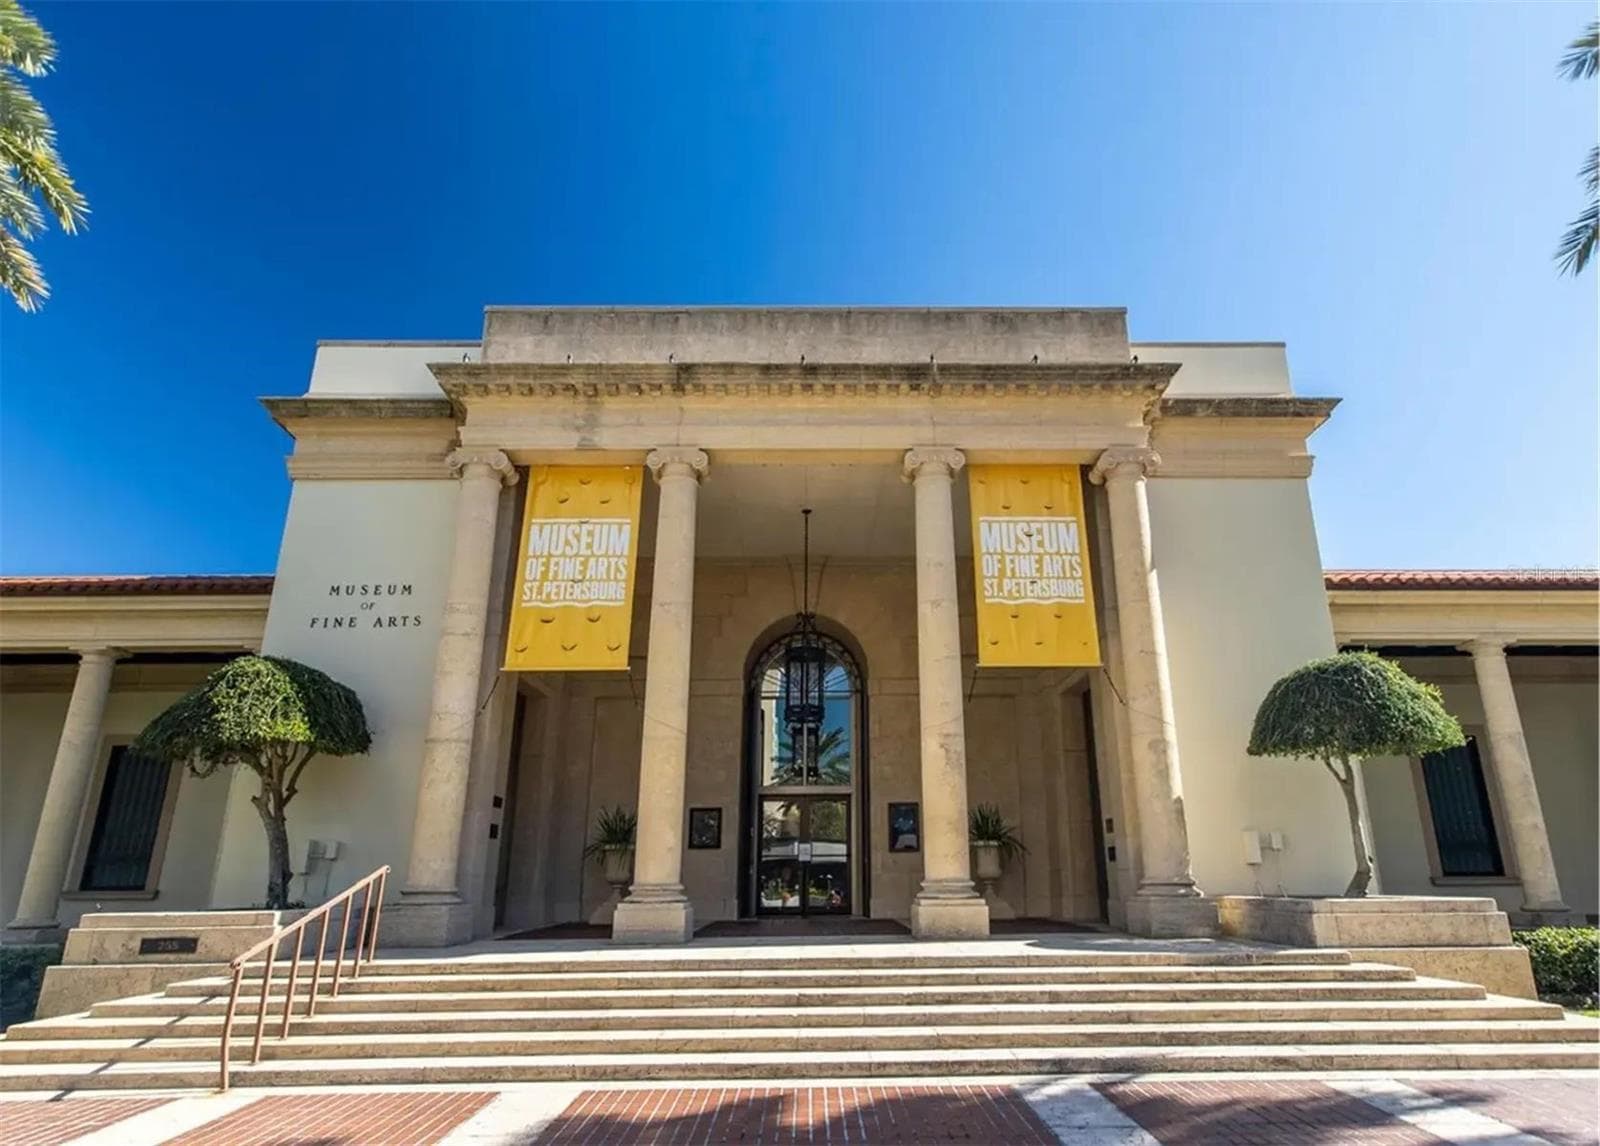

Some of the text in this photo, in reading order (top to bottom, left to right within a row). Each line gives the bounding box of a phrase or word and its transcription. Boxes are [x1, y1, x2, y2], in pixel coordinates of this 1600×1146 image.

[527, 523, 630, 557] MUSEUM
[980, 521, 1079, 554] MUSEUM
[525, 557, 628, 581] OF FINE ARTS
[982, 554, 1083, 577] OF FINE ARTS
[329, 584, 413, 596] MUSEUM
[360, 602, 376, 610] OF
[310, 615, 422, 628] FINE ARTS
